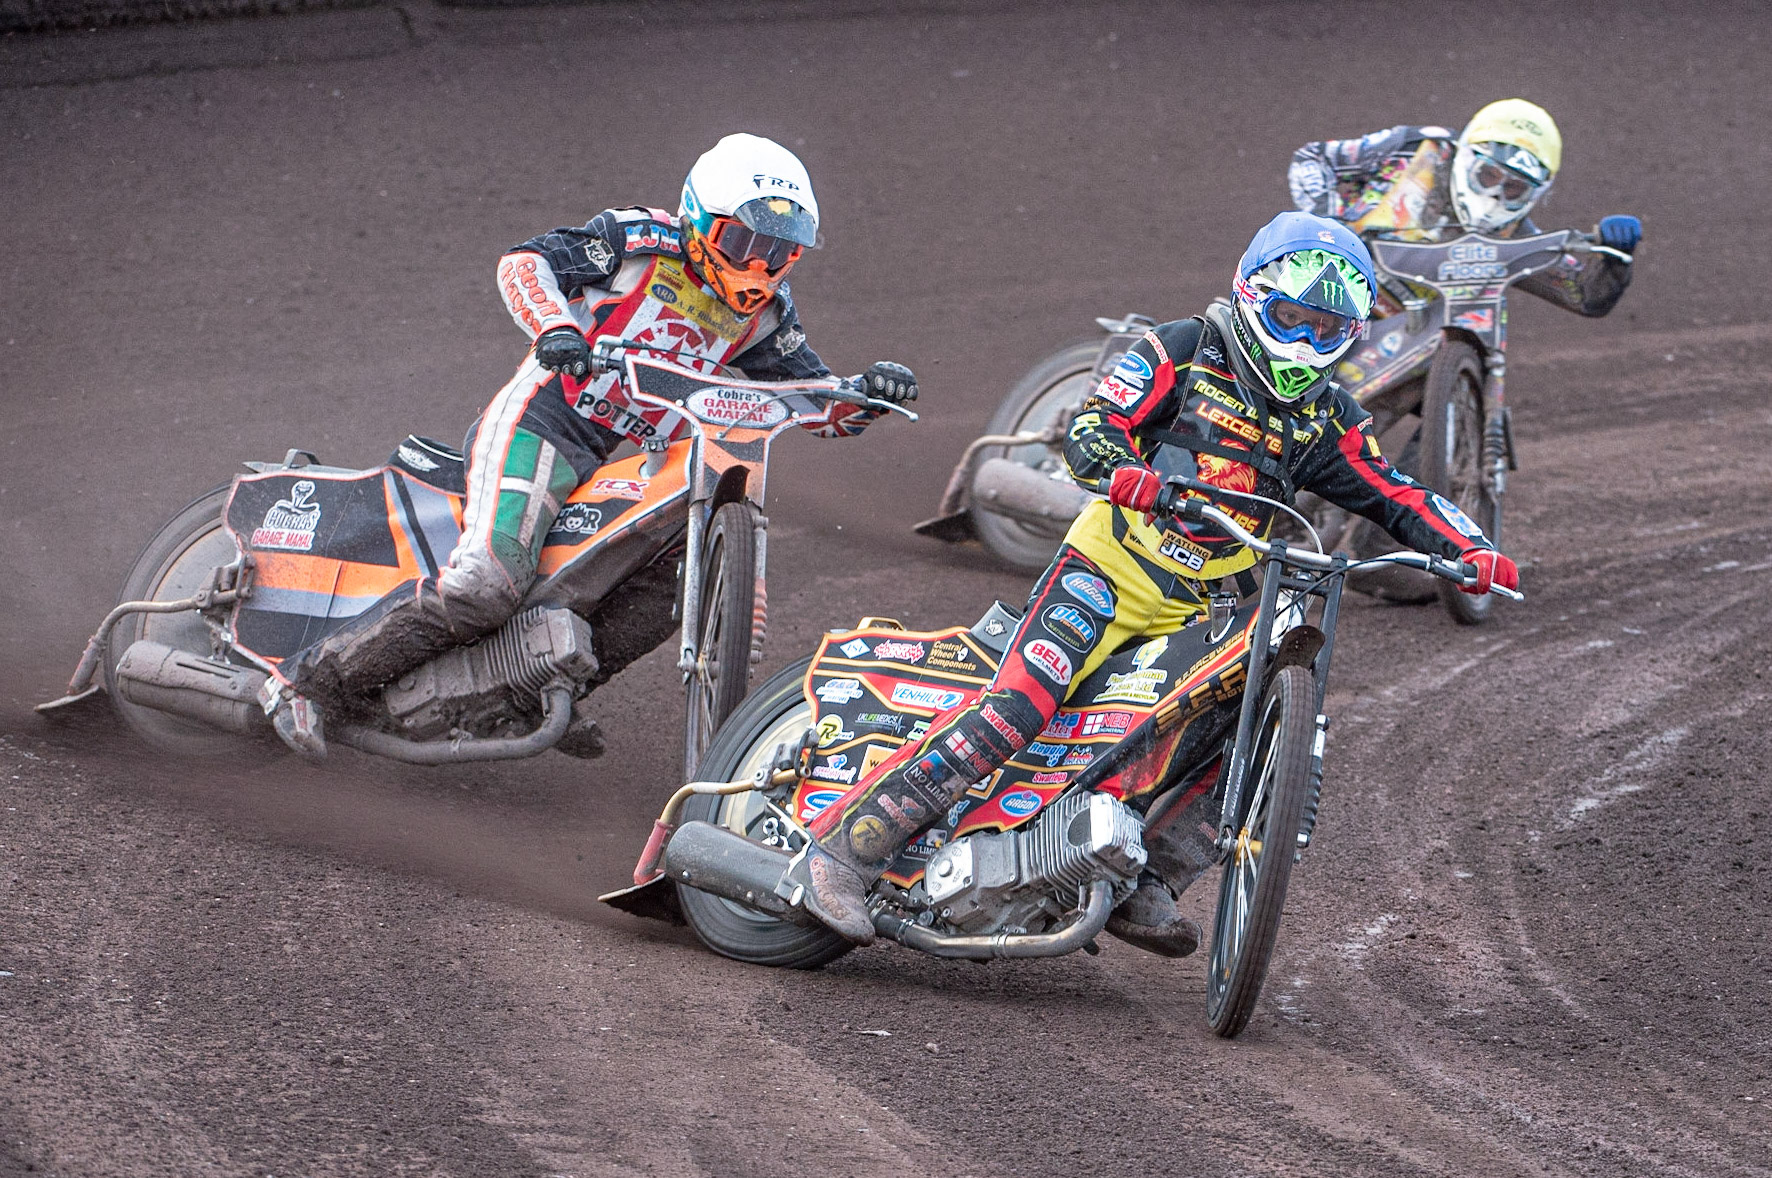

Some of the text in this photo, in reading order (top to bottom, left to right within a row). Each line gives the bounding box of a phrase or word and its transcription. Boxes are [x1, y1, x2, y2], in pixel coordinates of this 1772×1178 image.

[624, 224, 683, 253] KJM
[1450, 244, 1498, 261] Elite
[516, 256, 562, 317] Geoff
[1295, 354, 1310, 363] BELL
[717, 388, 761, 402] Cobra's
[1194, 379, 1246, 412] ROGER
[576, 390, 657, 438] POTTER
[1196, 401, 1284, 455] LEICESTE
[266, 508, 317, 531] COBRAS
[1159, 542, 1205, 571] JCB
[1165, 531, 1209, 559] WATLING
[1048, 605, 1094, 641] gbm
[930, 648, 956, 660] Wheel
[933, 640, 963, 651] Central
[926, 655, 977, 671] Components
[1030, 642, 1069, 681] BELL
[894, 686, 941, 704] VENHILL
[981, 703, 1026, 751] Swarfeg
[1101, 712, 1132, 728] NEB
[910, 766, 929, 785] NO
